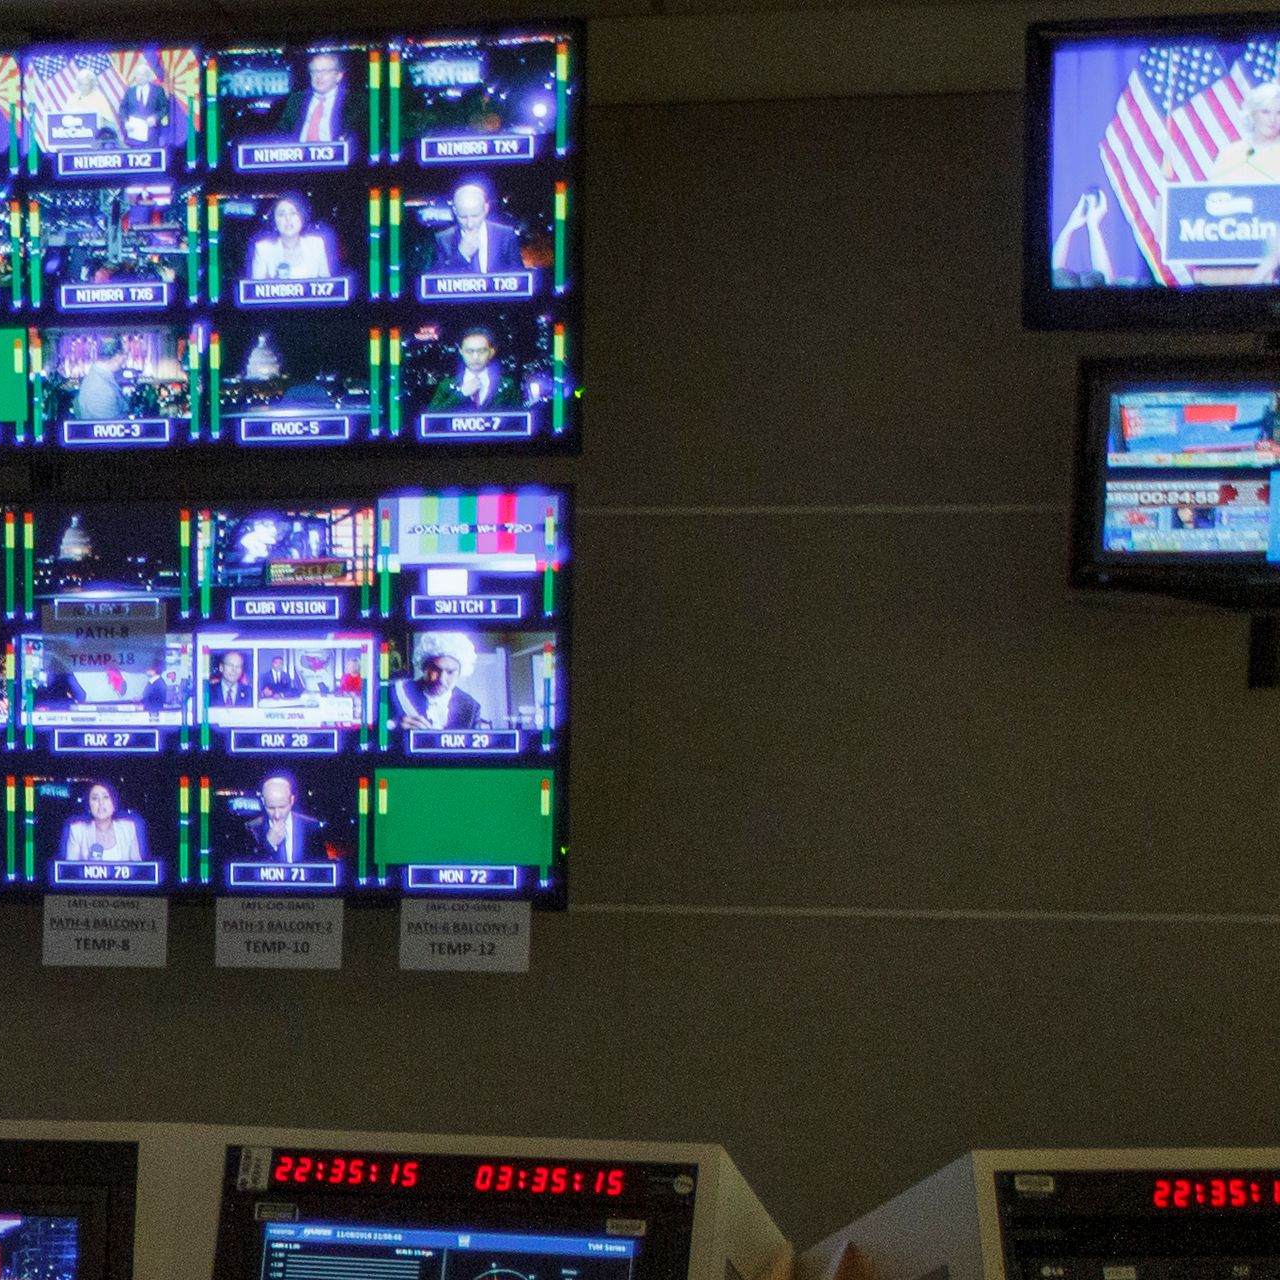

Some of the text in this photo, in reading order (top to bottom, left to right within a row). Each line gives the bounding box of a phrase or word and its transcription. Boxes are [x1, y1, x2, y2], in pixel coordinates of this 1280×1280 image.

[254, 147, 334, 162] NIMBRA TX3
[437, 140, 518, 155] NIMBRA TX4
[74, 154, 151, 168] NIMBRA TX2
[1179, 217, 1277, 242] McCain
[255, 280, 334, 297] NIMBRA TX7
[437, 277, 518, 292] NIMBRA TX8
[77, 288, 154, 302] NIMBRA TX6
[94, 423, 140, 437] AVOC-3
[272, 421, 319, 435] AVOC-5
[452, 417, 501, 431] AVOC-7
[245, 601, 326, 614] CUBA VISION
[435, 599, 497, 613] SWITCH 1
[71, 653, 135, 666] TEMP-18
[84, 733, 130, 746] AUX 27
[261, 733, 308, 747] AUX 28
[441, 734, 489, 748] AUX 29
[84, 865, 130, 879] MON 70
[260, 867, 305, 881] MON 71
[439, 869, 487, 883] MON 72
[75, 938, 130, 951] TEMP-8
[244, 941, 310, 953] TEMP-10
[429, 942, 495, 955] TEMP-12
[274, 1156, 419, 1188] 22:35:15
[474, 1164, 624, 1196] 03:35:15
[588, 1243, 626, 1252] TVM Series
